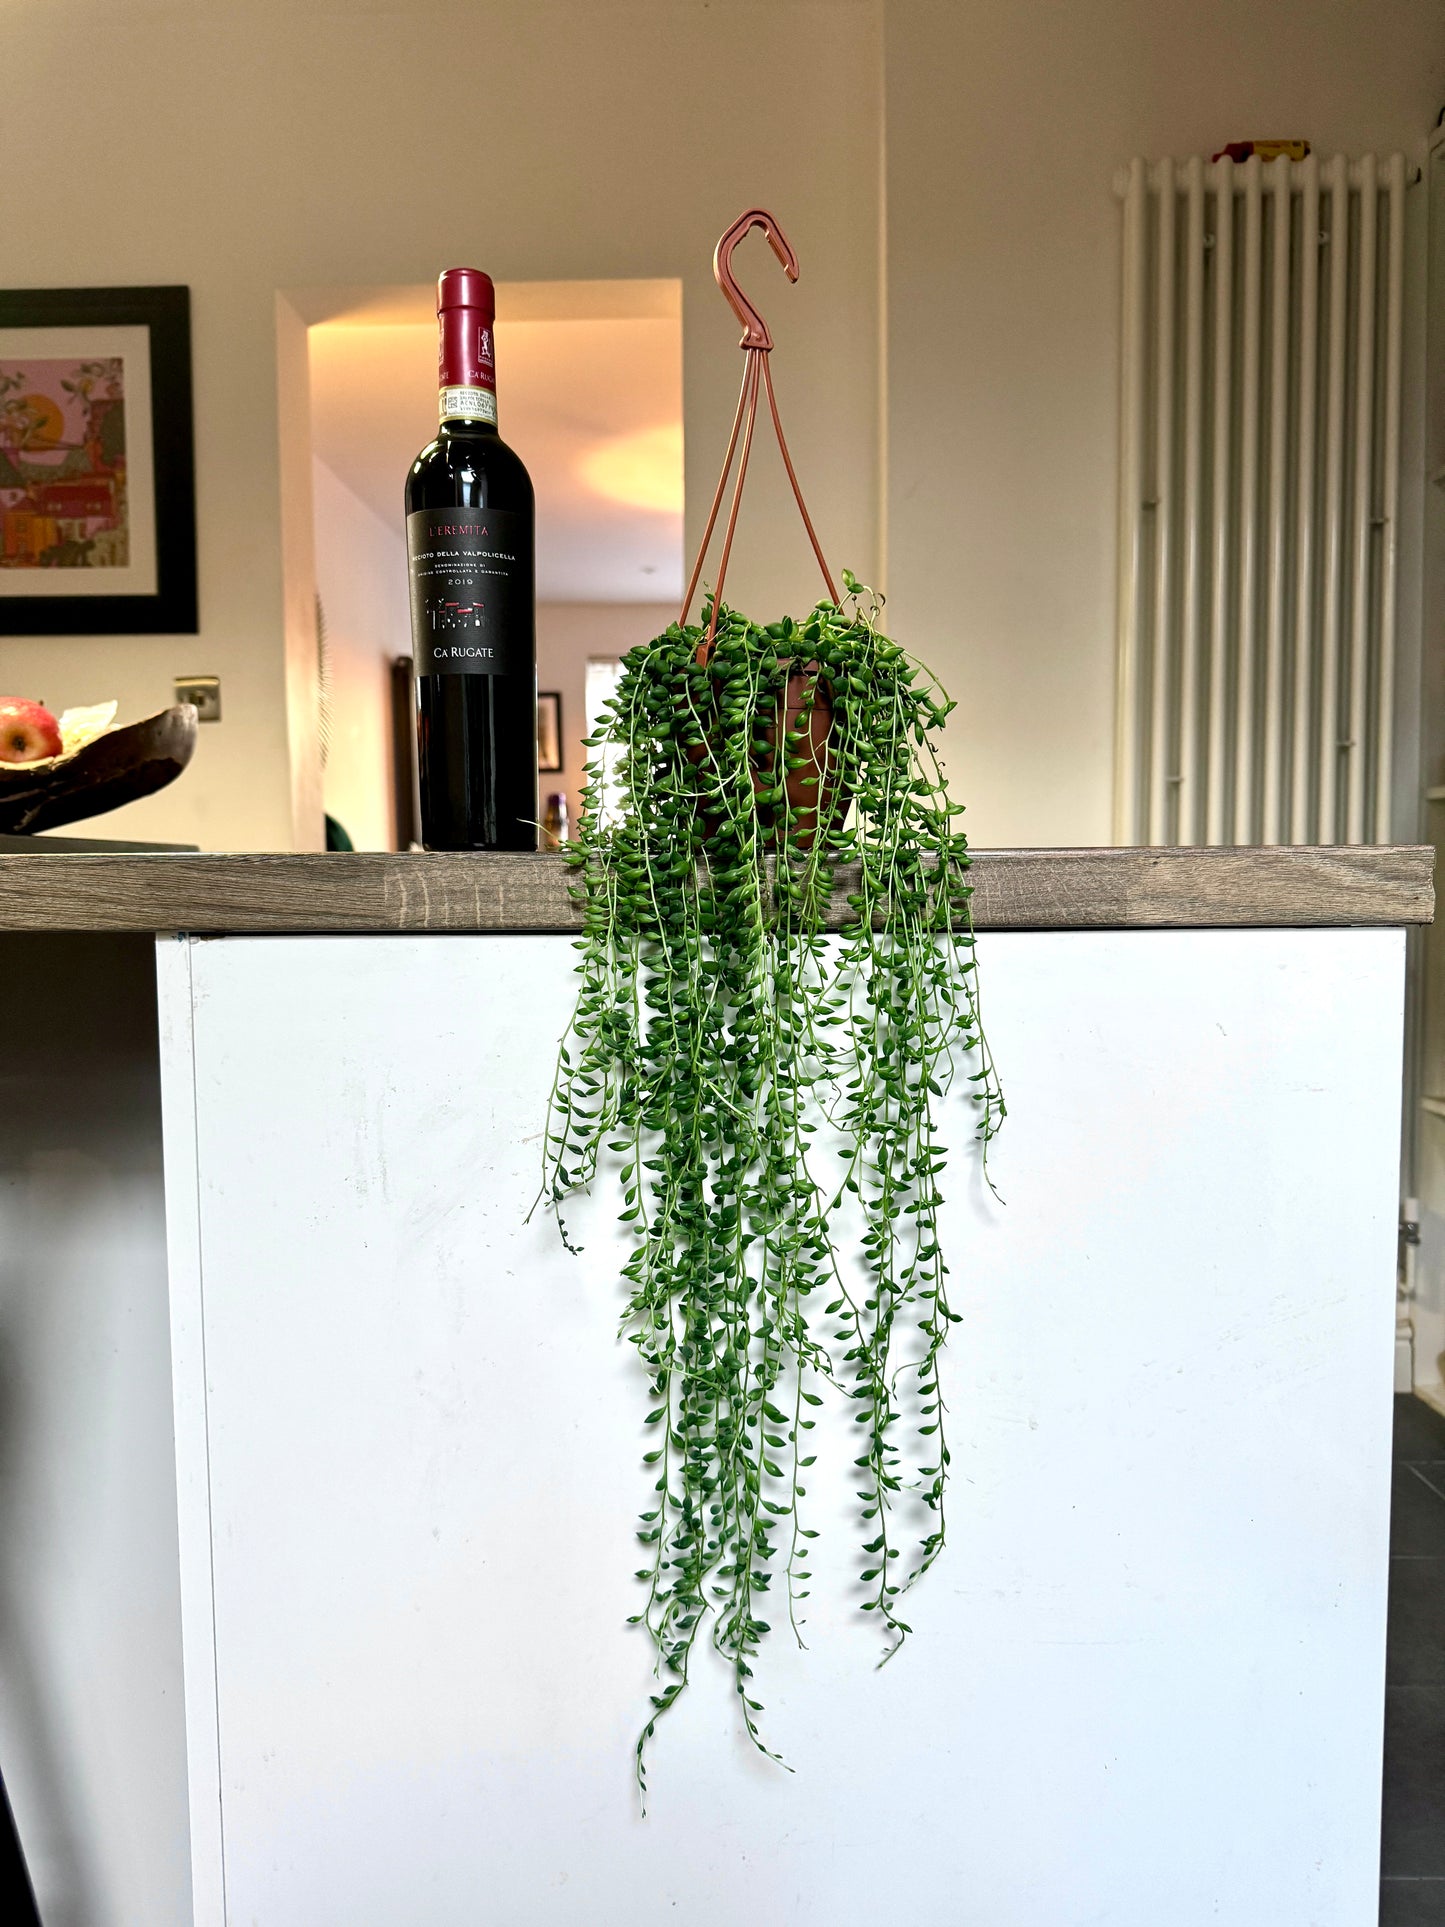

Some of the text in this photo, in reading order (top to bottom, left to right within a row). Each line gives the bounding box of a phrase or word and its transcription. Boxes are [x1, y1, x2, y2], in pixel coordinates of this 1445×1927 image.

[429, 525, 489, 537] L'EREMITA
[462, 551, 516, 561] VALPOLICELLA
[451, 647, 494, 658] RUGATE
